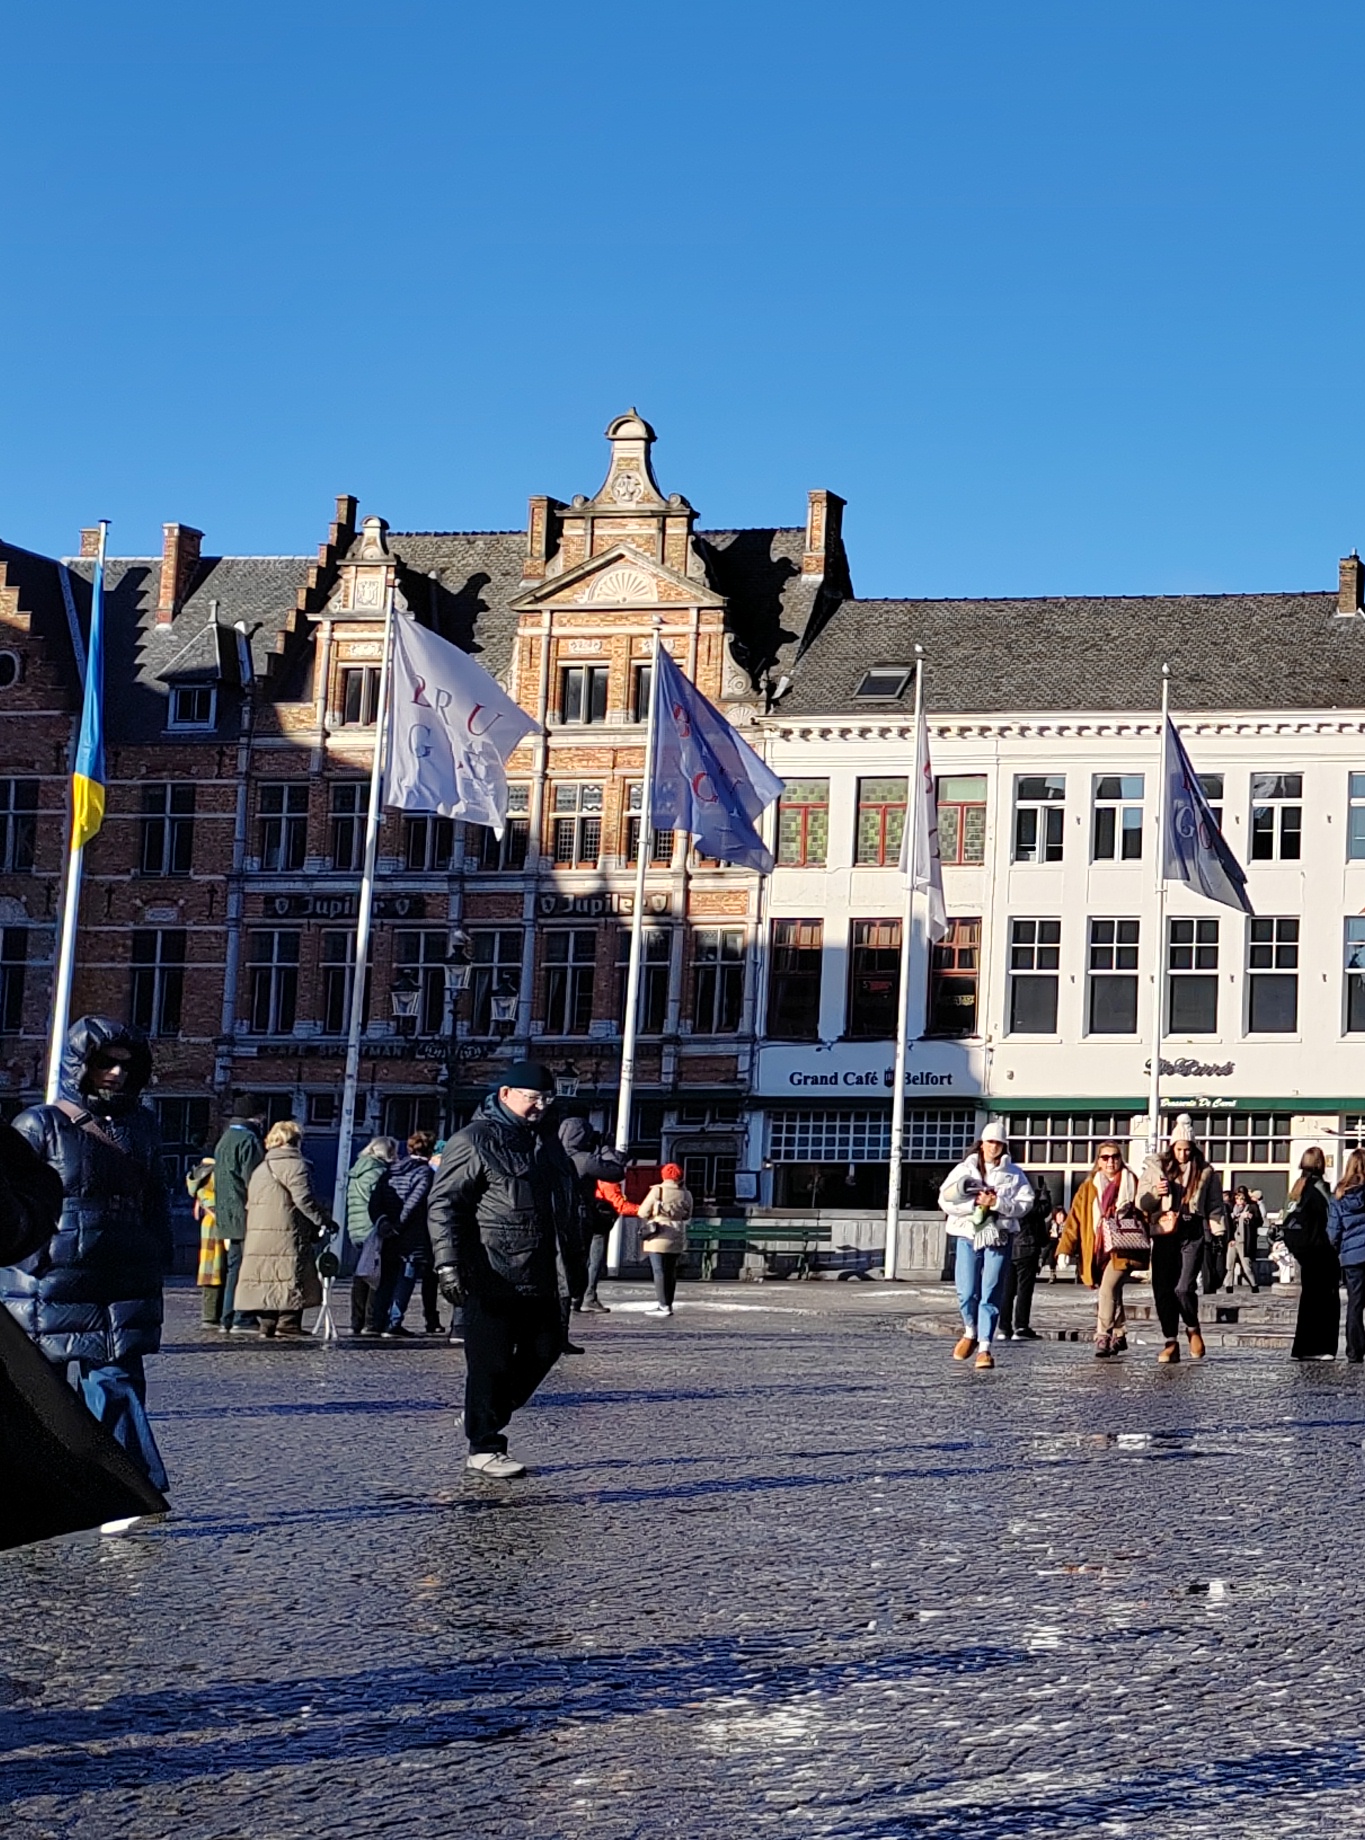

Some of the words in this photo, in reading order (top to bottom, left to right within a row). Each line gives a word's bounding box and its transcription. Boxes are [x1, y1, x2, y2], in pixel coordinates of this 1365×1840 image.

[302, 896, 384, 918] Jupilr
[319, 1044, 403, 1056] SPOTMAN
[789, 1072, 838, 1086] Grand
[842, 1071, 879, 1086] Café
[904, 1072, 953, 1086] Belfort
